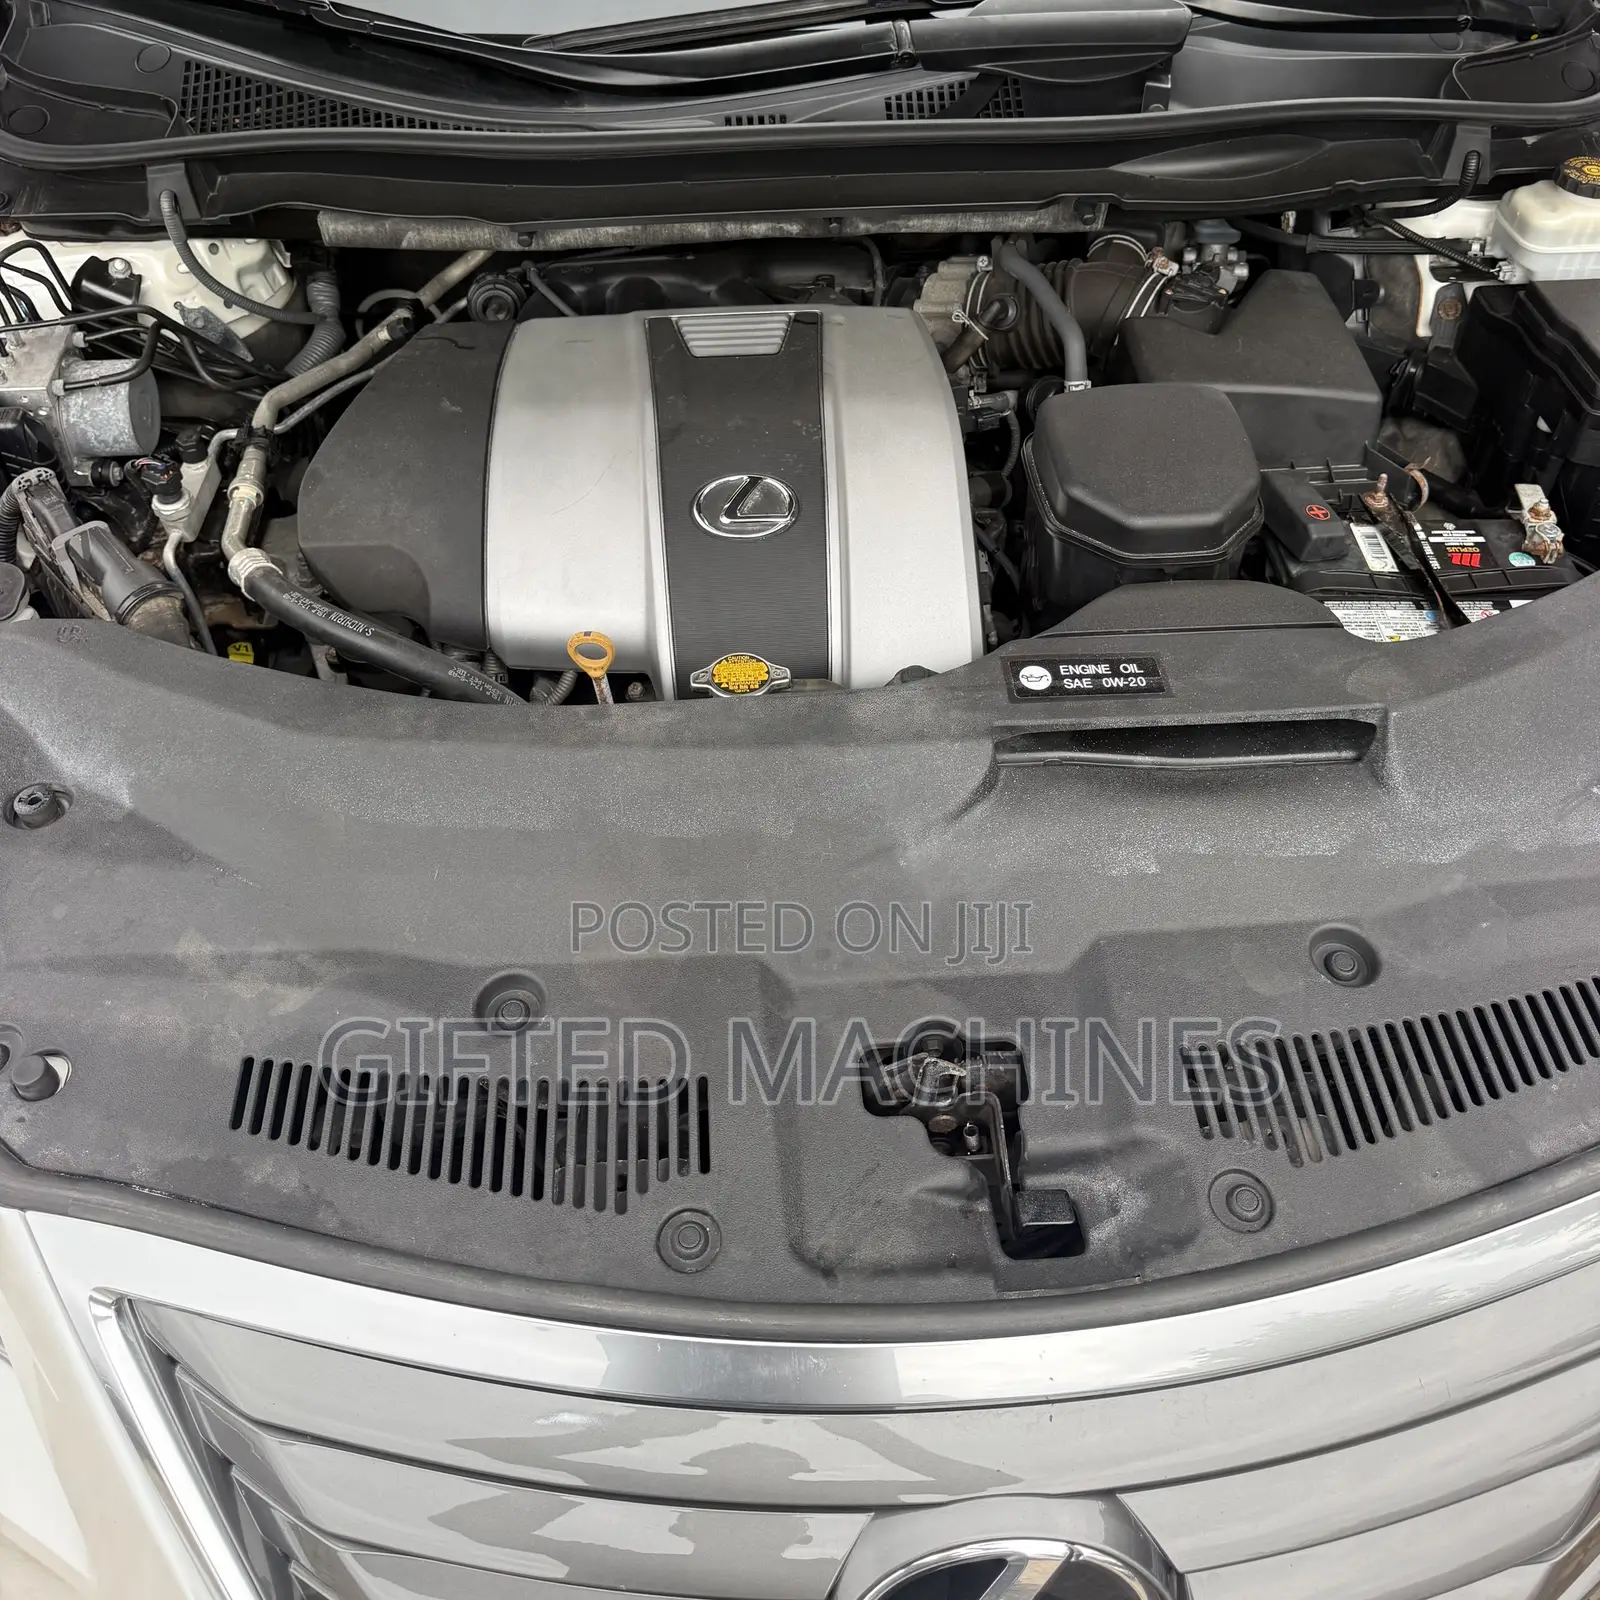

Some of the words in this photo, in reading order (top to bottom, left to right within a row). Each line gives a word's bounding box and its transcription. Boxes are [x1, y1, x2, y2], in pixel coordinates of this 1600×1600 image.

[232, 643, 249, 653] V1
[1059, 664, 1112, 676] ENGINE
[1119, 663, 1144, 674] OIL
[1063, 678, 1094, 689] SAE
[1102, 676, 1147, 688] 0W-20
